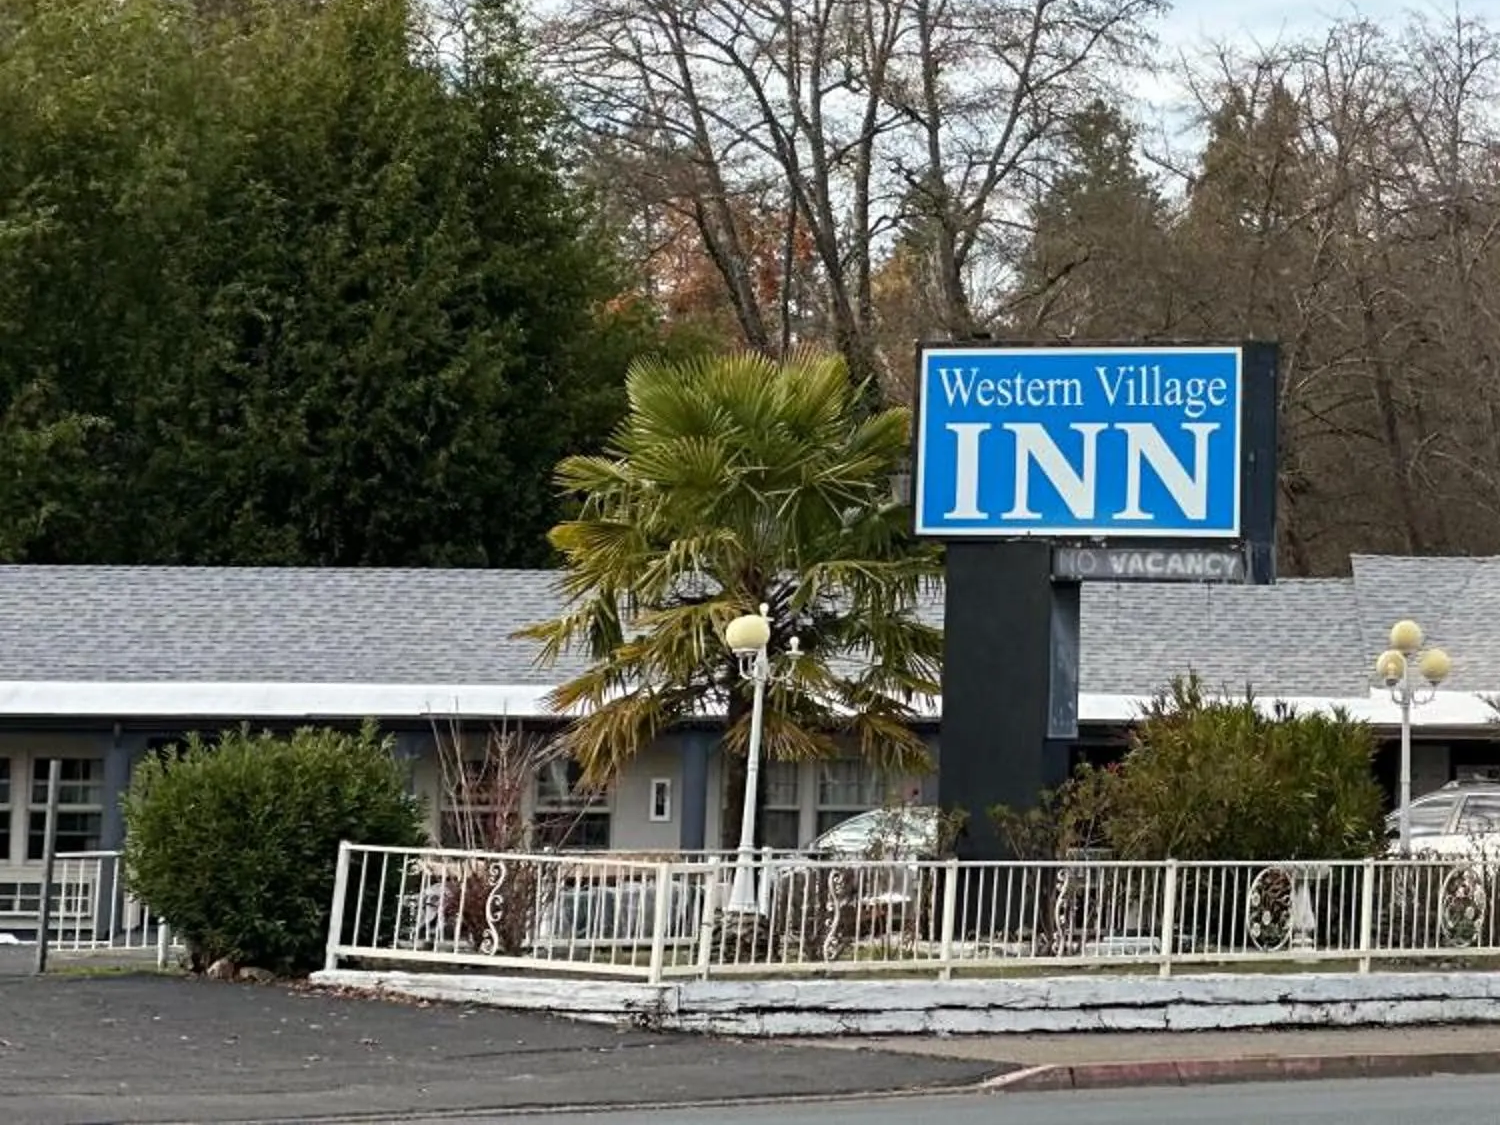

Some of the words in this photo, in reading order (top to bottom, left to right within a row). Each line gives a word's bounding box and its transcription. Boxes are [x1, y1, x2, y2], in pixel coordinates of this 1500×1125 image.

[939, 368, 1084, 407] Western
[1096, 365, 1228, 418] Village
[944, 422, 1221, 520] INN
[1059, 550, 1097, 574] NO
[1109, 552, 1237, 574] VACANCY
